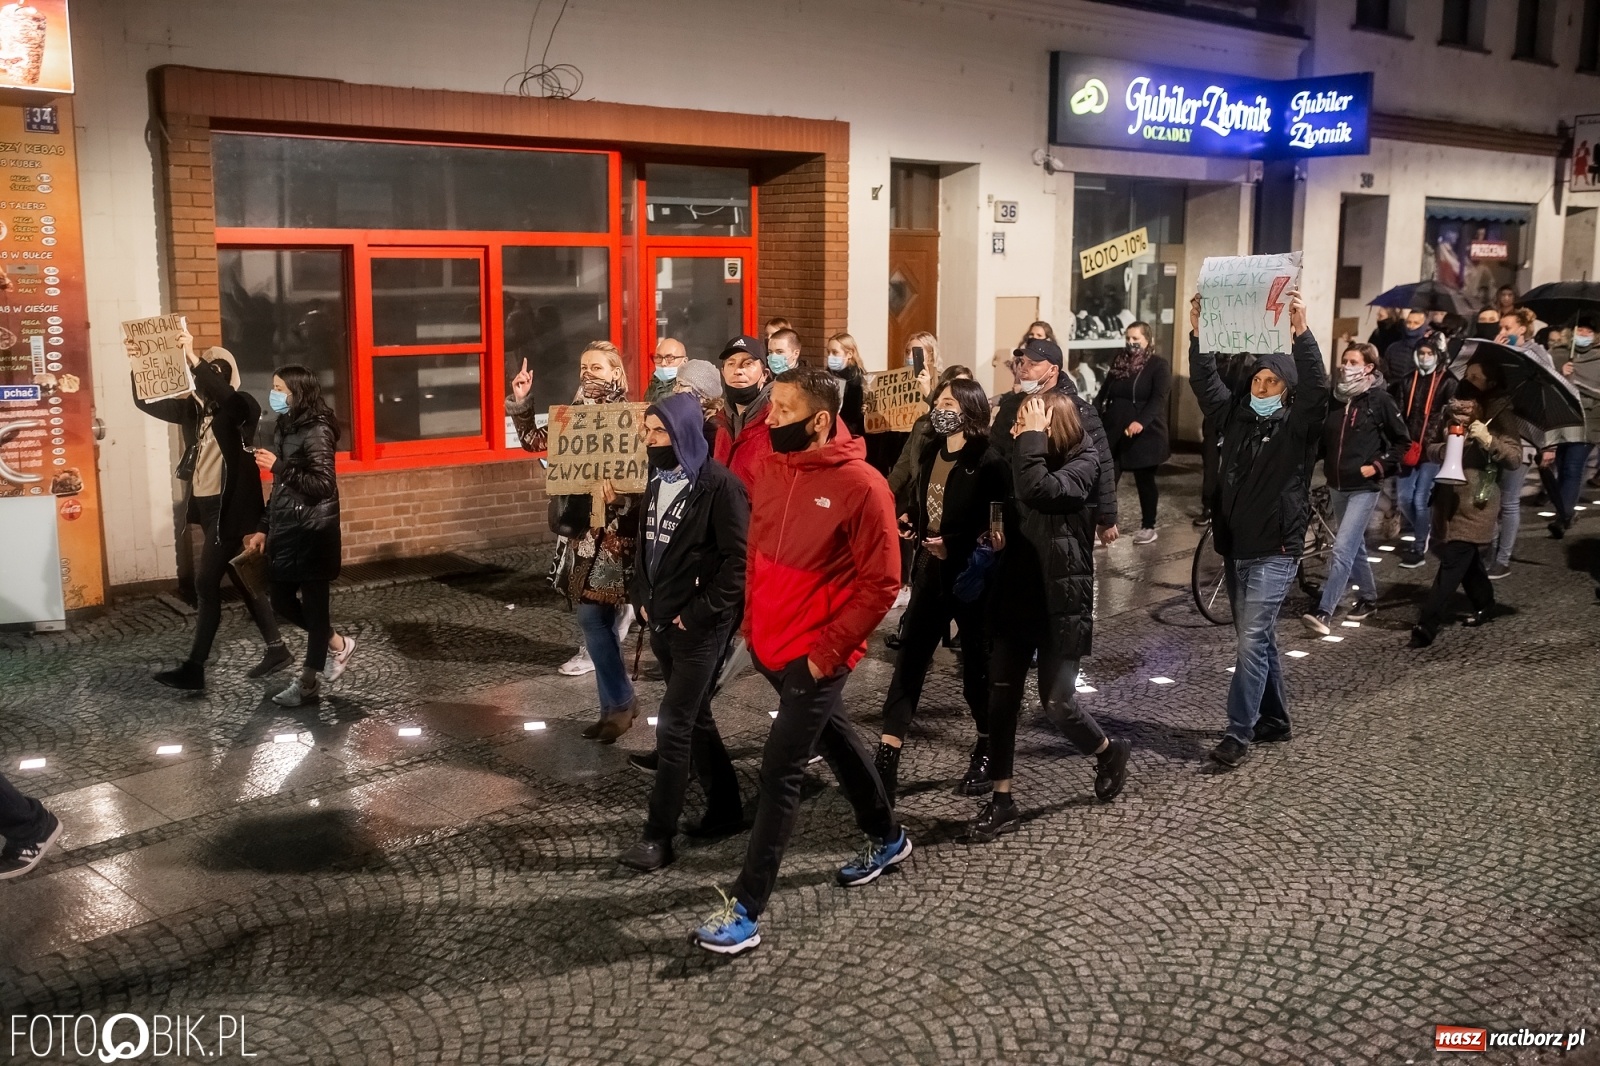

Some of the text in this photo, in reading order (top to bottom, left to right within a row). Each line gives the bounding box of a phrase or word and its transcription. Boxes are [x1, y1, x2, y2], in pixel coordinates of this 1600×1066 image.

[1126, 76, 1271, 136] Jubiler Złotnik
[1290, 90, 1354, 122] Jubiler
[32, 108, 52, 123] 34
[1289, 122, 1352, 149] Złotnik
[25, 144, 65, 155] KEBAB
[10, 160, 42, 168] KUBEK
[9, 202, 46, 210] TALERZ
[1001, 205, 1016, 218] 36
[22, 251, 53, 259] BUŁCE
[1083, 233, 1147, 273] ZŁOTO -10%
[1202, 291, 1257, 312] TO TAM
[13, 305, 22, 313] W
[24, 303, 59, 313] CIEŚCIE
[164, 355, 173, 366] W
[4, 388, 34, 399] pchać
